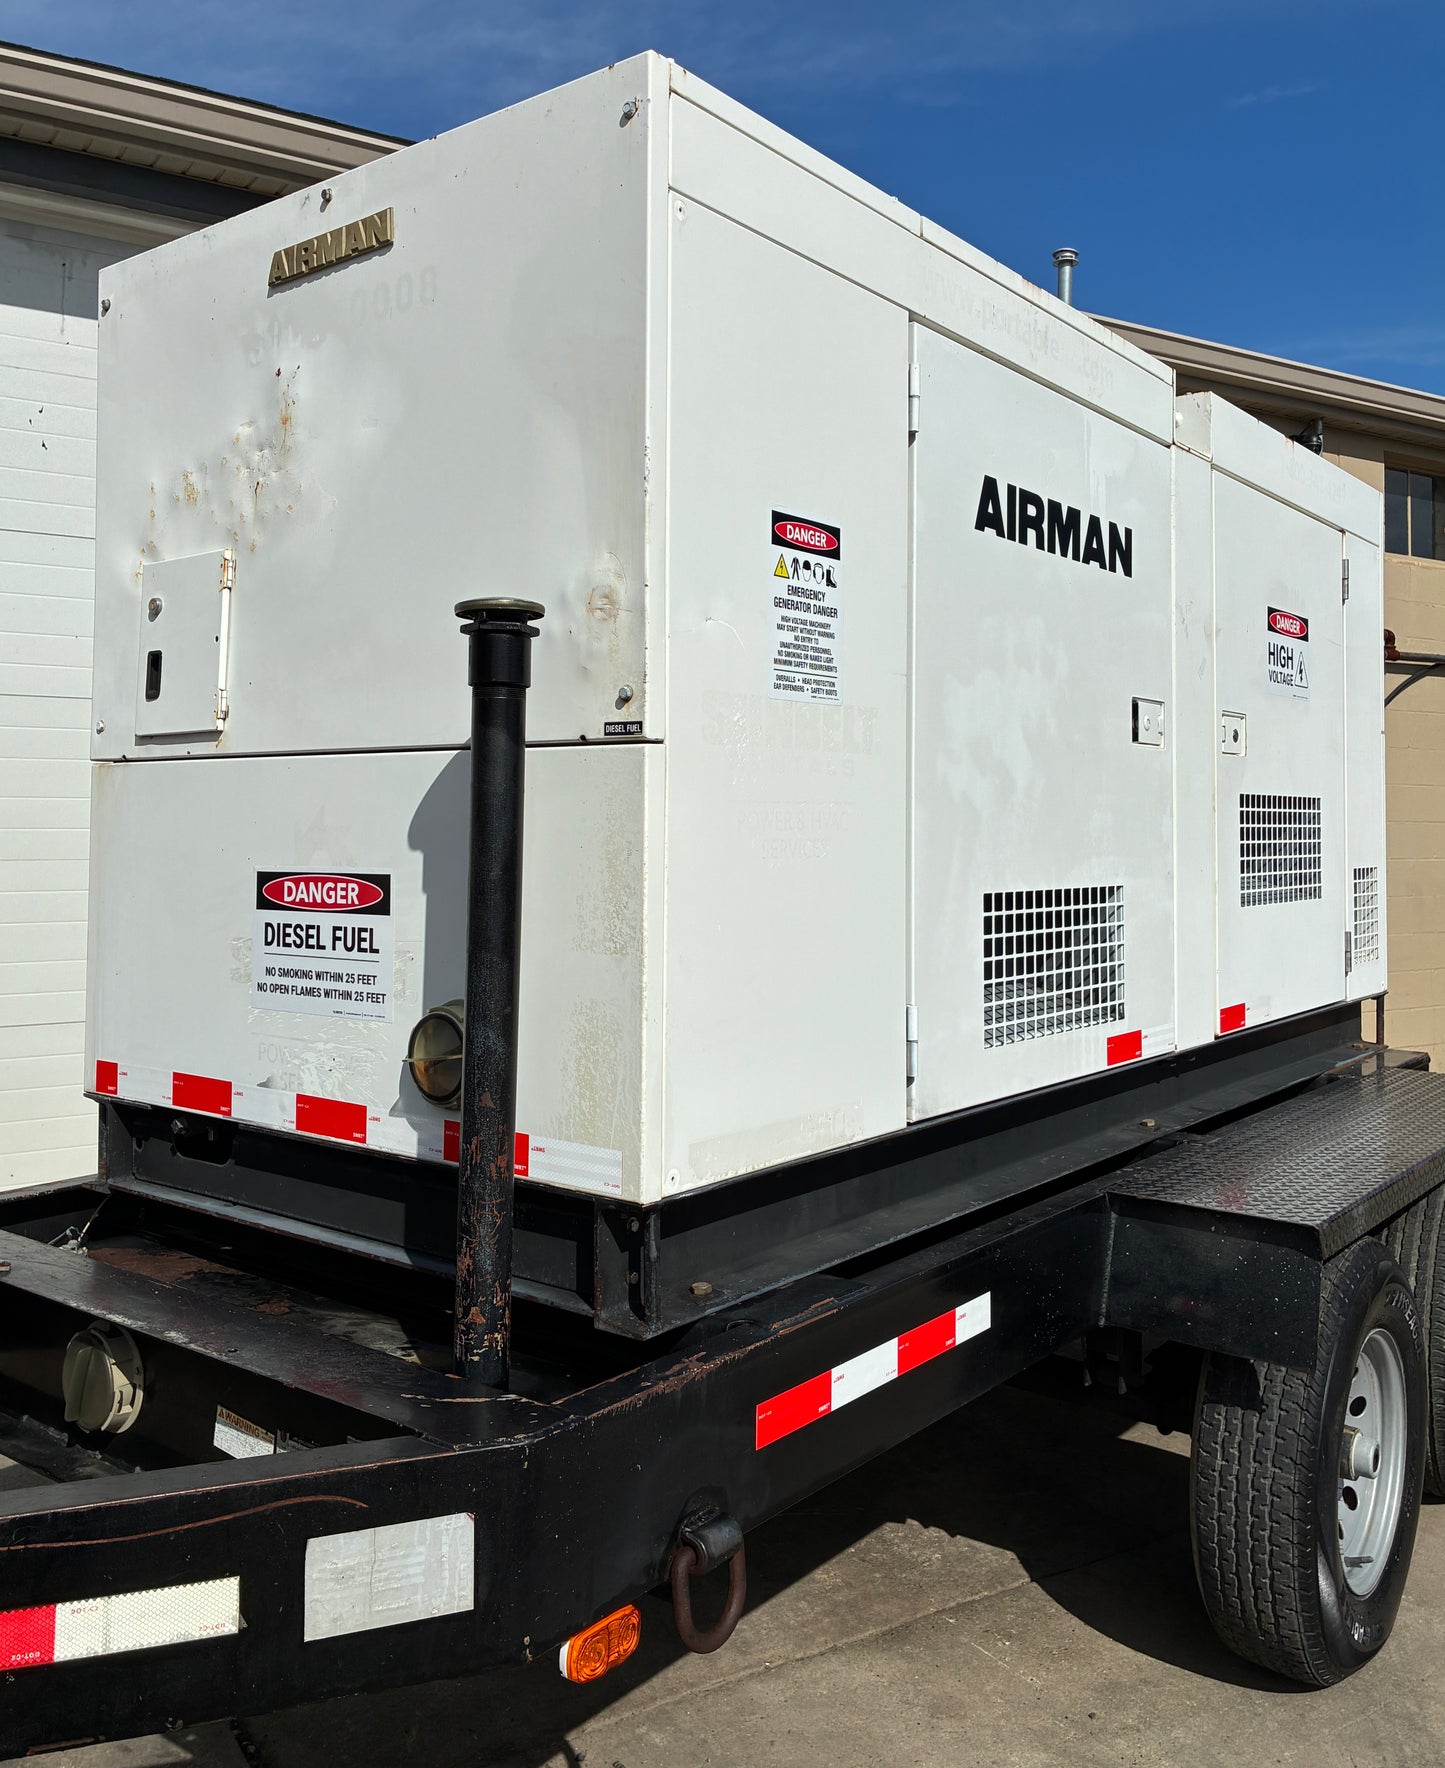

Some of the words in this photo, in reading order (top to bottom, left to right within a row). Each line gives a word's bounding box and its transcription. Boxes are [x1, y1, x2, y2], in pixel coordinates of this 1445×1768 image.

[269, 207, 393, 283] AIRMAN
[974, 474, 1133, 578] AIRMAN
[786, 524, 827, 548] DANGER
[787, 584, 826, 602] EMERGENCY
[774, 596, 812, 614] GENERATOR
[813, 604, 838, 619] DANGER
[776, 623, 786, 631] MAY
[786, 624, 799, 633] START
[800, 627, 817, 636] WITHOUT
[818, 630, 836, 640] WARNING
[781, 614, 791, 623] HIGH
[792, 617, 808, 626] VOLTAGE
[809, 620, 831, 630] MACHINERY
[1276, 614, 1301, 634] DANGER
[780, 641, 810, 652] UNAUTHORIZED
[810, 645, 832, 656] PERSONNEL
[800, 636, 813, 644] ENTRY
[774, 658, 792, 666] MINIMUM
[794, 660, 808, 669] SAFETY
[809, 662, 838, 673] REQUIREMENTS
[784, 650, 802, 660] SMOKING
[810, 654, 822, 663] NAKED
[822, 656, 834, 664] LIGHT
[1268, 642, 1294, 670] HIGH
[776, 674, 796, 684] OVERALLS
[802, 677, 812, 686] HEAD
[812, 678, 836, 688] PROTECTION
[1268, 668, 1294, 687] VOLTAGE
[774, 682, 782, 690] EAR
[782, 683, 805, 692] DEFENDERS
[810, 686, 824, 695] SAFETY
[825, 688, 838, 696] BOOTS
[605, 724, 626, 732] DIESEL
[626, 724, 641, 732] FUEL
[283, 881, 360, 905] DANGER
[264, 921, 326, 950] DIESEL
[332, 925, 380, 954] FUEL
[266, 966, 277, 977] NO
[278, 967, 314, 980] SMOKING
[314, 970, 344, 984] WITHIN
[345, 973, 356, 984] 25
[357, 974, 378, 986] FEET
[257, 982, 268, 992] NO
[269, 983, 290, 994] OPEN
[290, 985, 322, 998] FLAMES
[323, 988, 352, 1001] WITHIN
[354, 991, 364, 1002] 25
[366, 992, 386, 1004] FEET
[225, 1411, 260, 1438] WARNING
